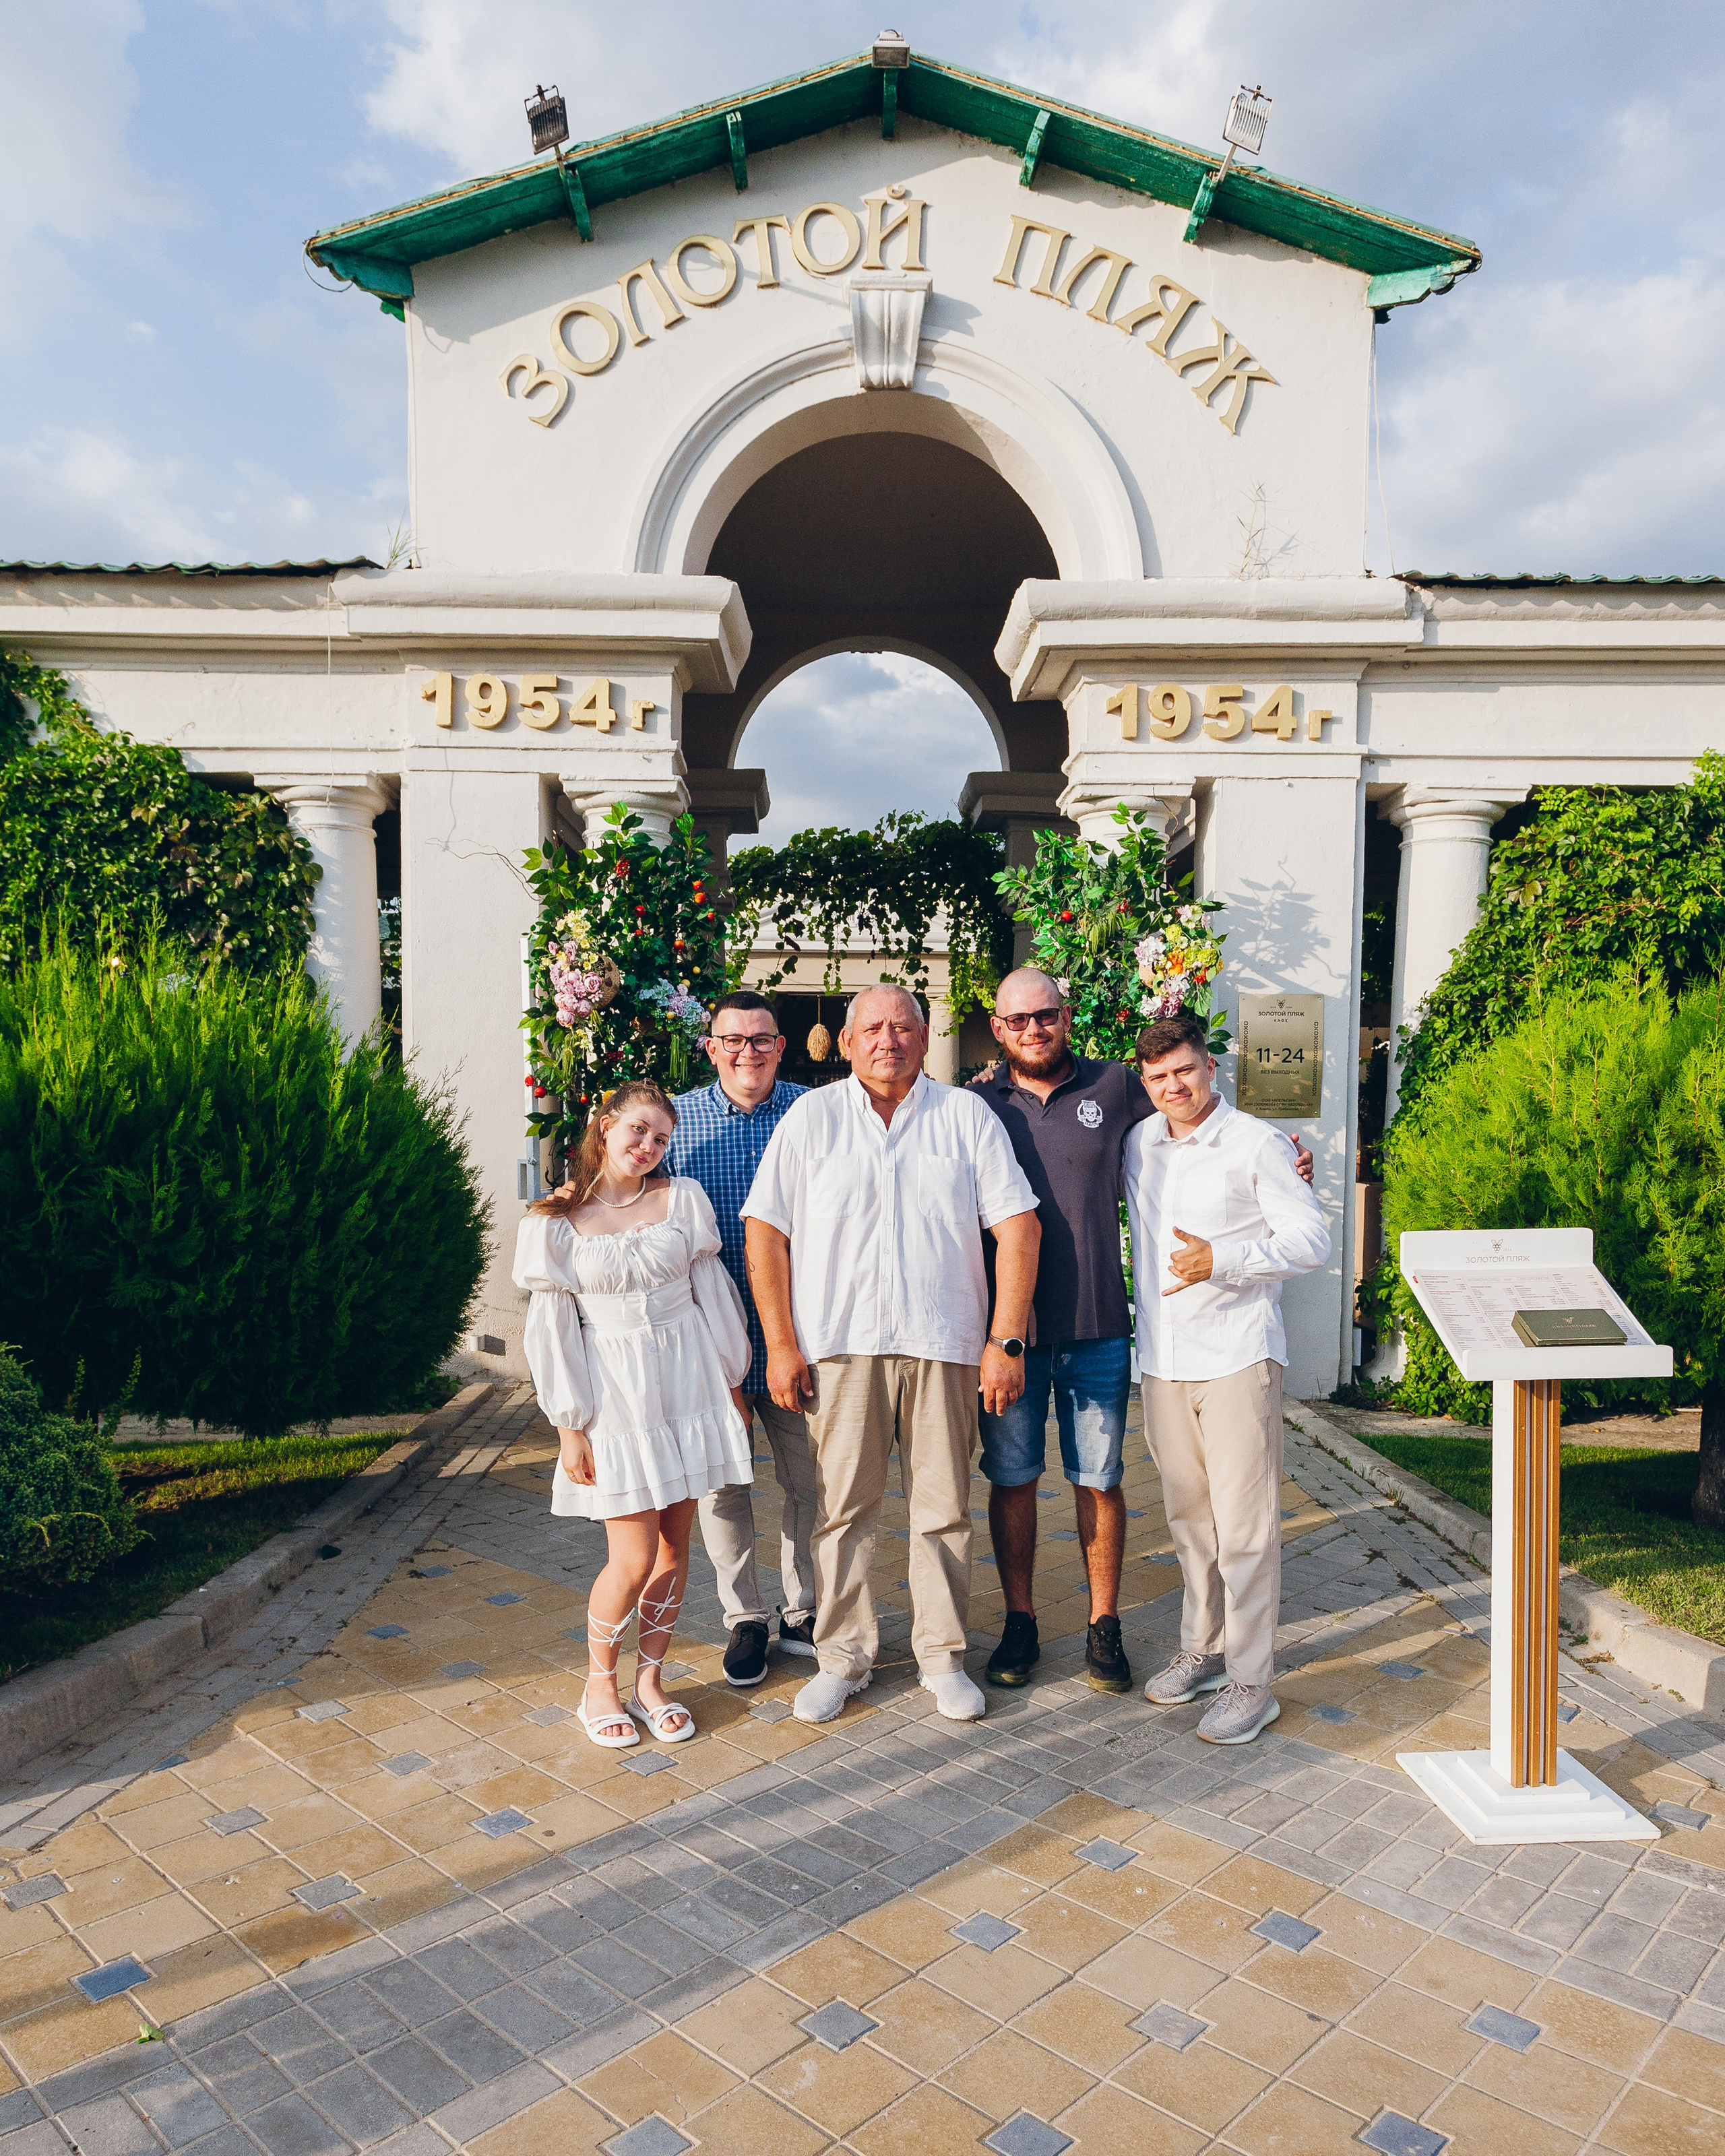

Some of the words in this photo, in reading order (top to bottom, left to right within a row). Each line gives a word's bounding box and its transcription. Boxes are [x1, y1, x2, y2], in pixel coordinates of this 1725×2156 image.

[497, 185, 929, 429] ЗОЛОТОЙ
[993, 214, 1280, 437] ПЛЯЖ
[1256, 1048, 1305, 1063] 11-24
[1466, 1255, 1504, 1263] ЗОЛОТОЙ
